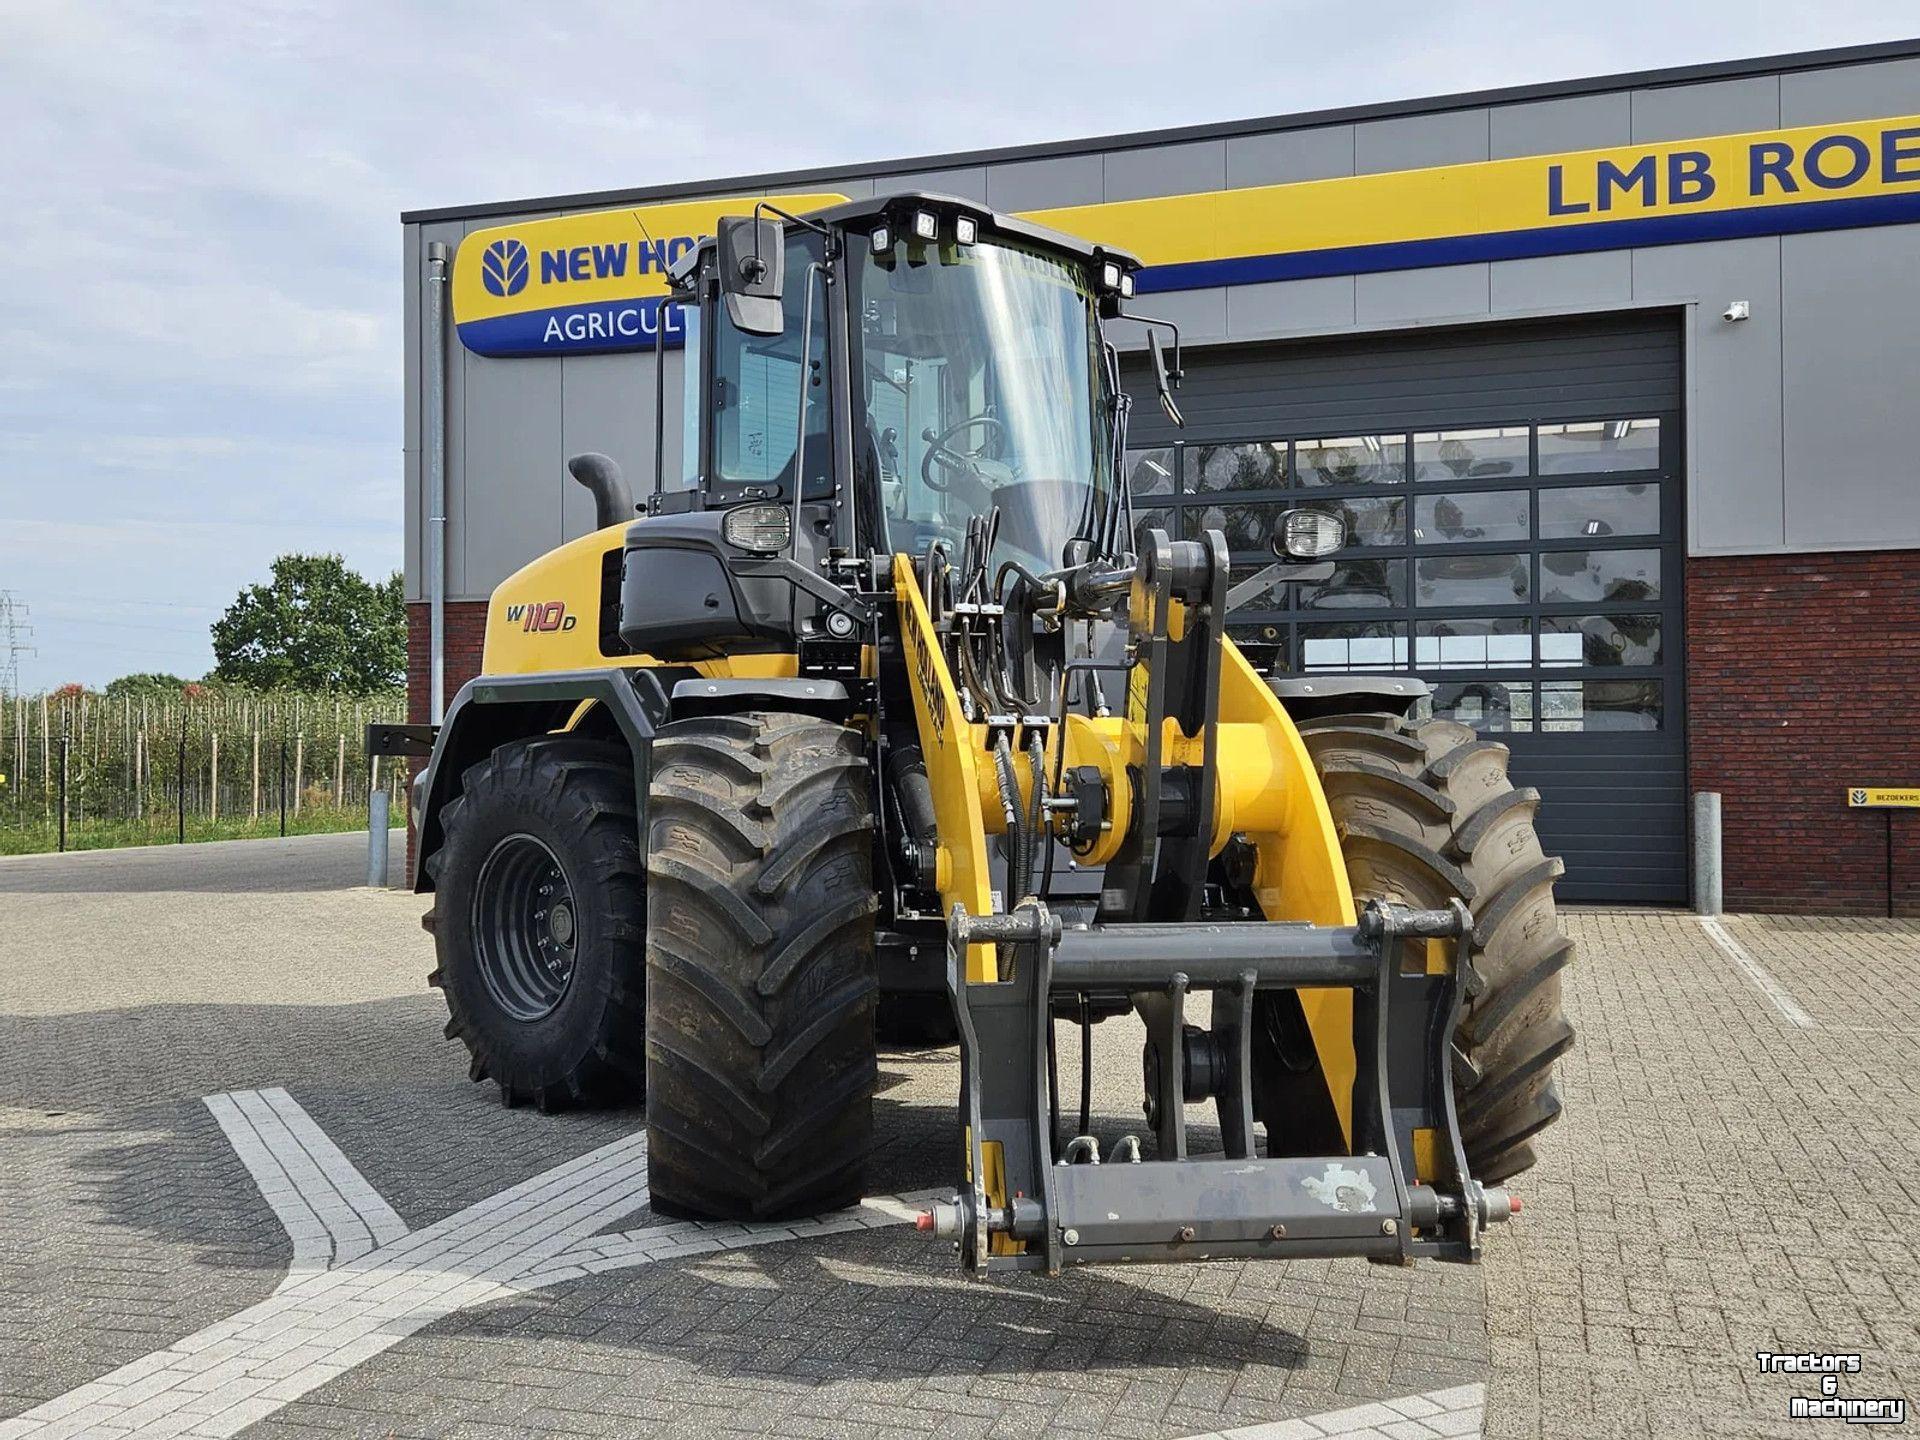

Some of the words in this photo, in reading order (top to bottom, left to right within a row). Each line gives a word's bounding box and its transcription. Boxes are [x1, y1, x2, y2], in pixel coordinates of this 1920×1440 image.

[1549, 151, 1716, 216] LMB
[1749, 127, 1920, 196] ROE
[541, 242, 628, 284] NEW
[638, 234, 706, 275] HO
